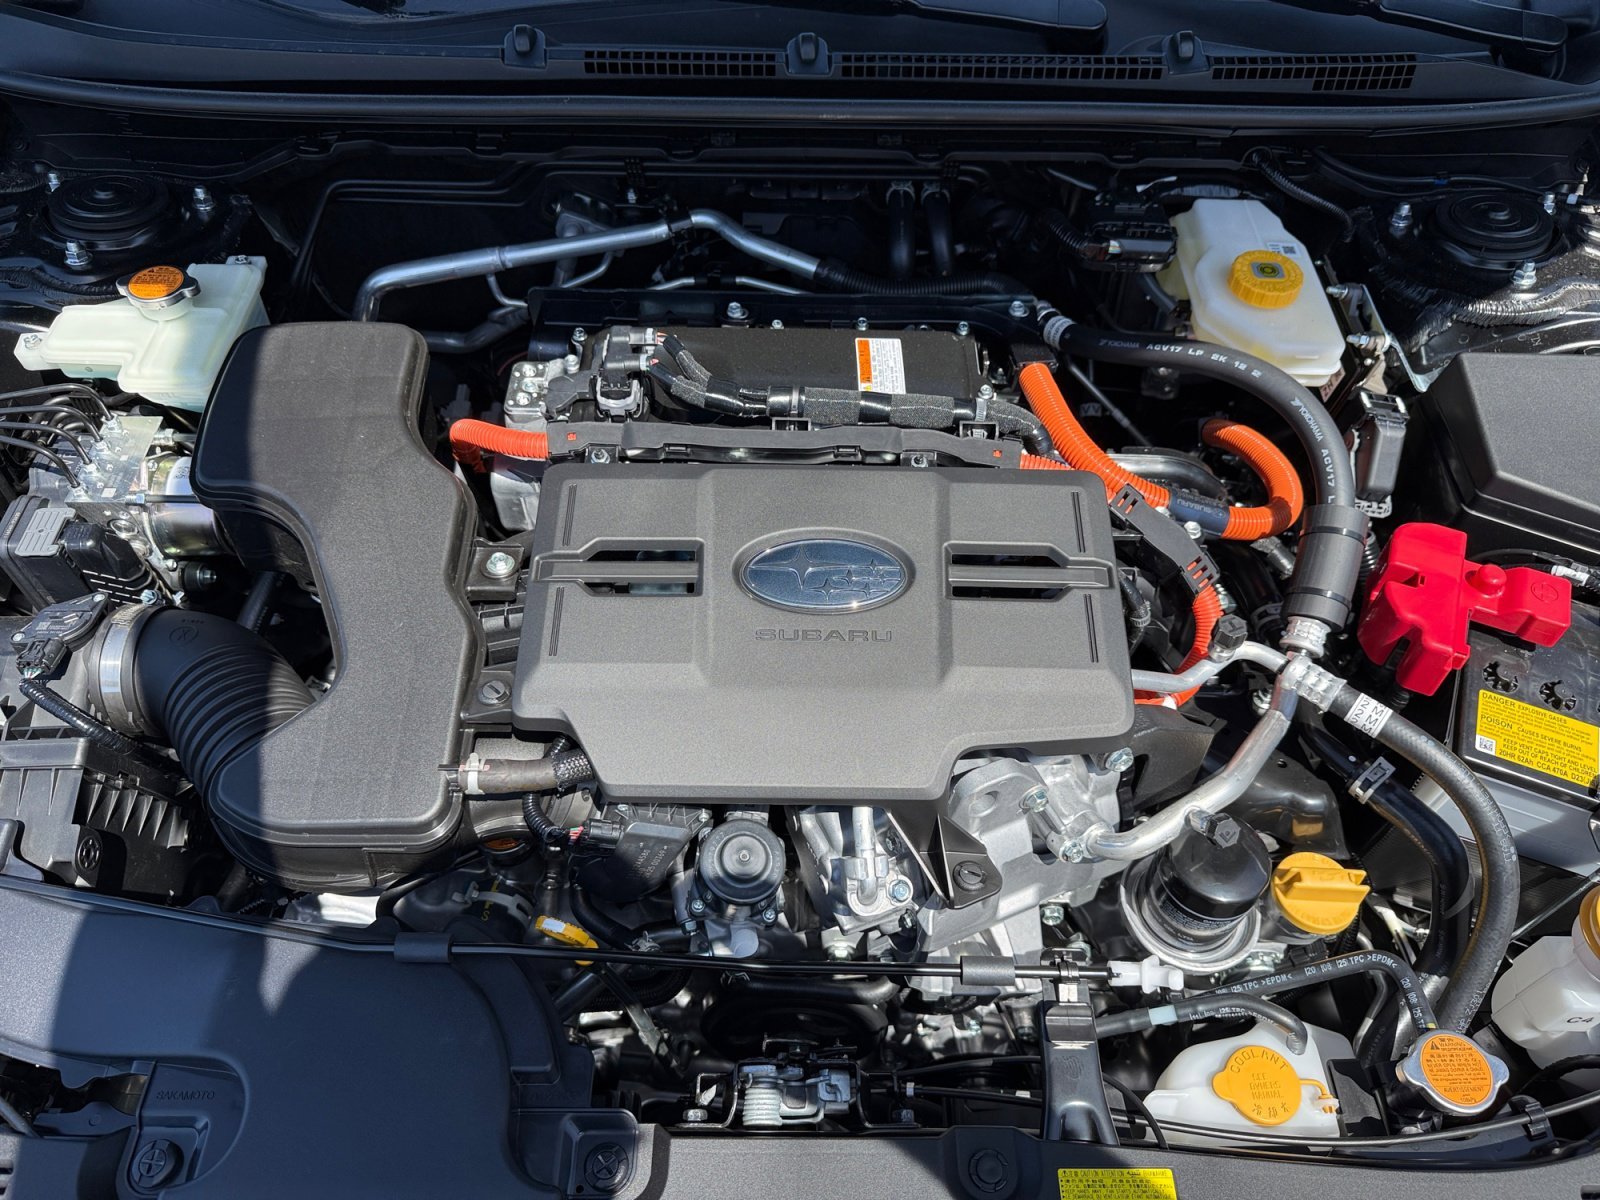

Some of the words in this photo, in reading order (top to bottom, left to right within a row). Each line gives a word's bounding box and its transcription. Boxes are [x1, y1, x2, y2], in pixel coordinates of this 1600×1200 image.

[1299, 404, 1324, 442] YOKOHAMA
[1321, 448, 1335, 487] ACV17
[755, 628, 893, 643] SUBARU
[1482, 692, 1516, 709] DANGER
[1517, 704, 1548, 719] EXPLOSIVE
[1548, 714, 1568, 725] GASES
[1480, 714, 1513, 730] POISON
[1517, 726, 1540, 739] CAUSES
[1540, 733, 1562, 745] SEVERE
[1562, 741, 1582, 752] BURNS
[1502, 744, 1518, 752] KEEP
[1539, 756, 1559, 766] REACH
[1503, 738, 1518, 746] KEEP
[1518, 743, 1533, 751] VENT
[1534, 747, 1550, 757] CAPS
[1550, 752, 1567, 763] TIGHT
[1567, 758, 1579, 767] AND
[1579, 763, 1597, 773] LEVEL
[1536, 761, 1551, 772] CCA
[1230, 1048, 1289, 1074] COOLANT
[156, 1089, 216, 1101] SAKAMOTO
